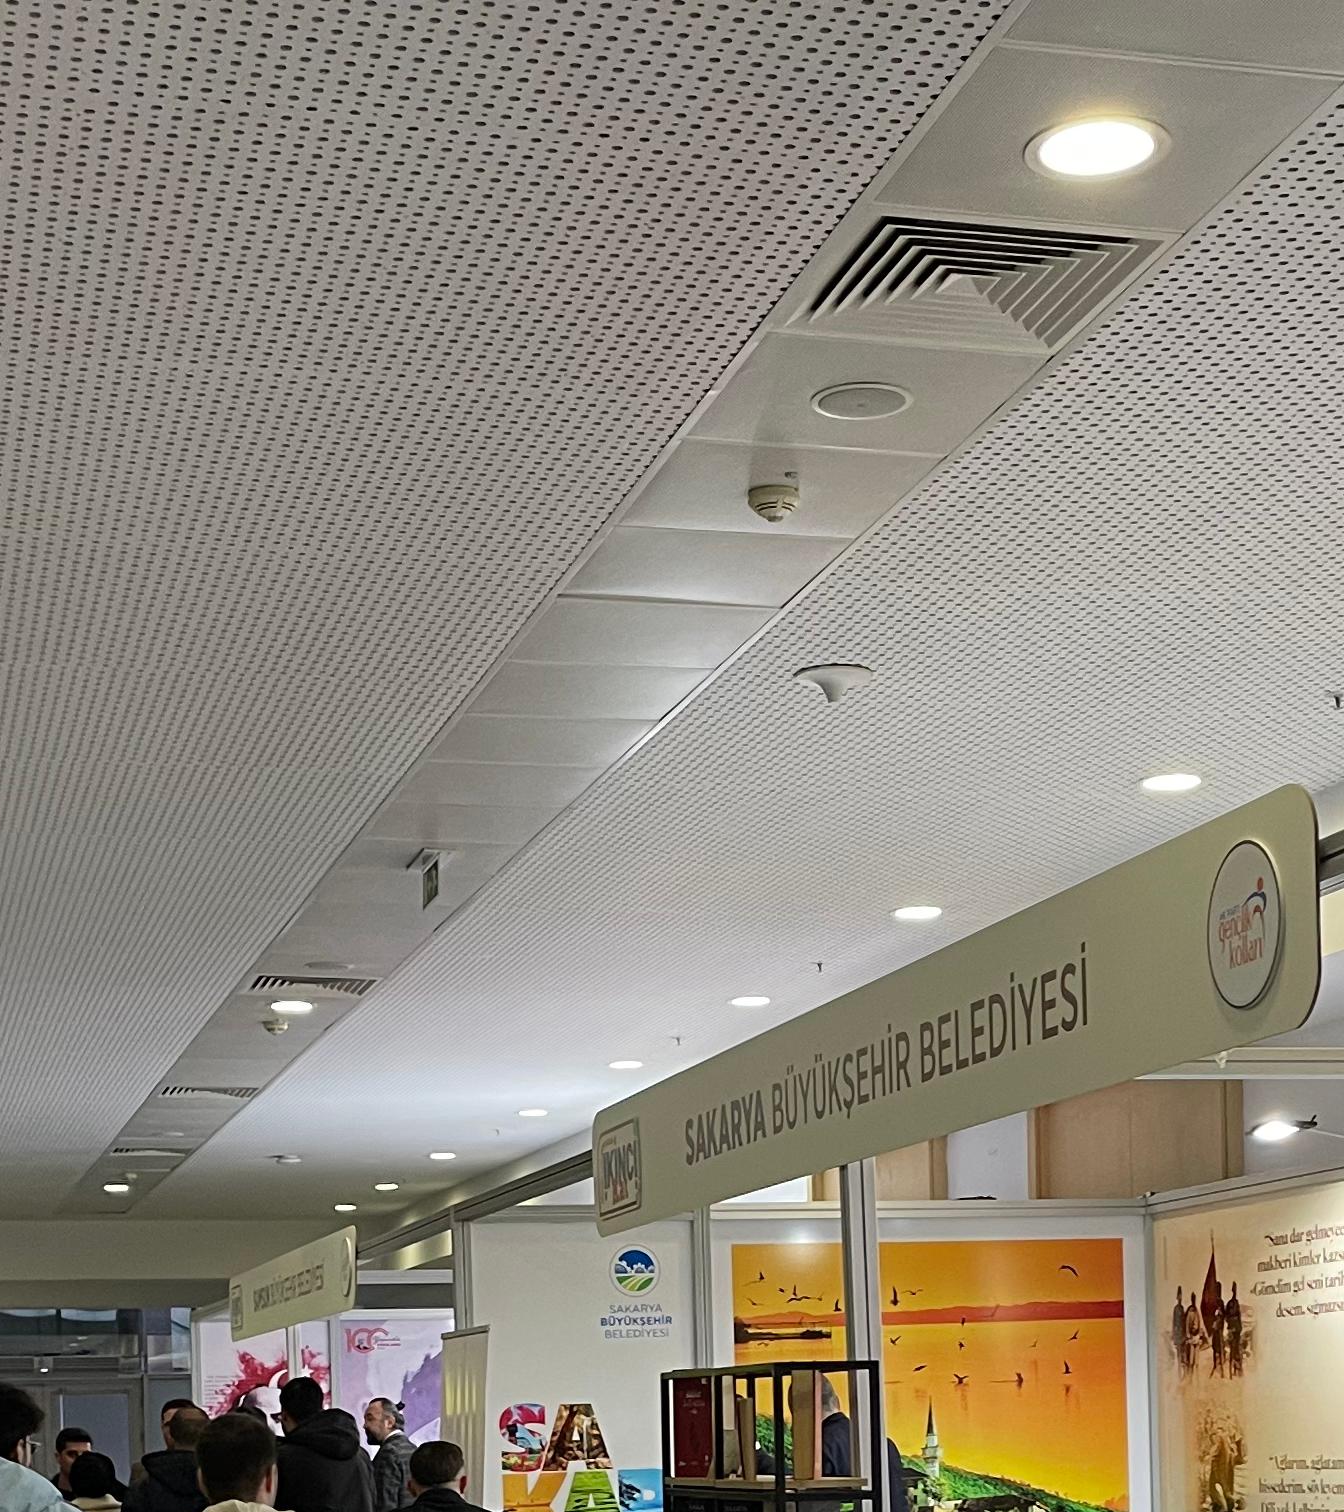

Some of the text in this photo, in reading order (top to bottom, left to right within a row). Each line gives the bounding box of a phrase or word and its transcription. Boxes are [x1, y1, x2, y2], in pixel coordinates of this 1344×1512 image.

[685, 941, 1088, 1166] SAKARYA BÜYÜKŞEHİR BELEDİYESİ
[609, 1303, 663, 1314] SAKARYA
[600, 1314, 673, 1327] BÜYÜKŞEHİR
[604, 1328, 670, 1340] BELEDİYESİ
